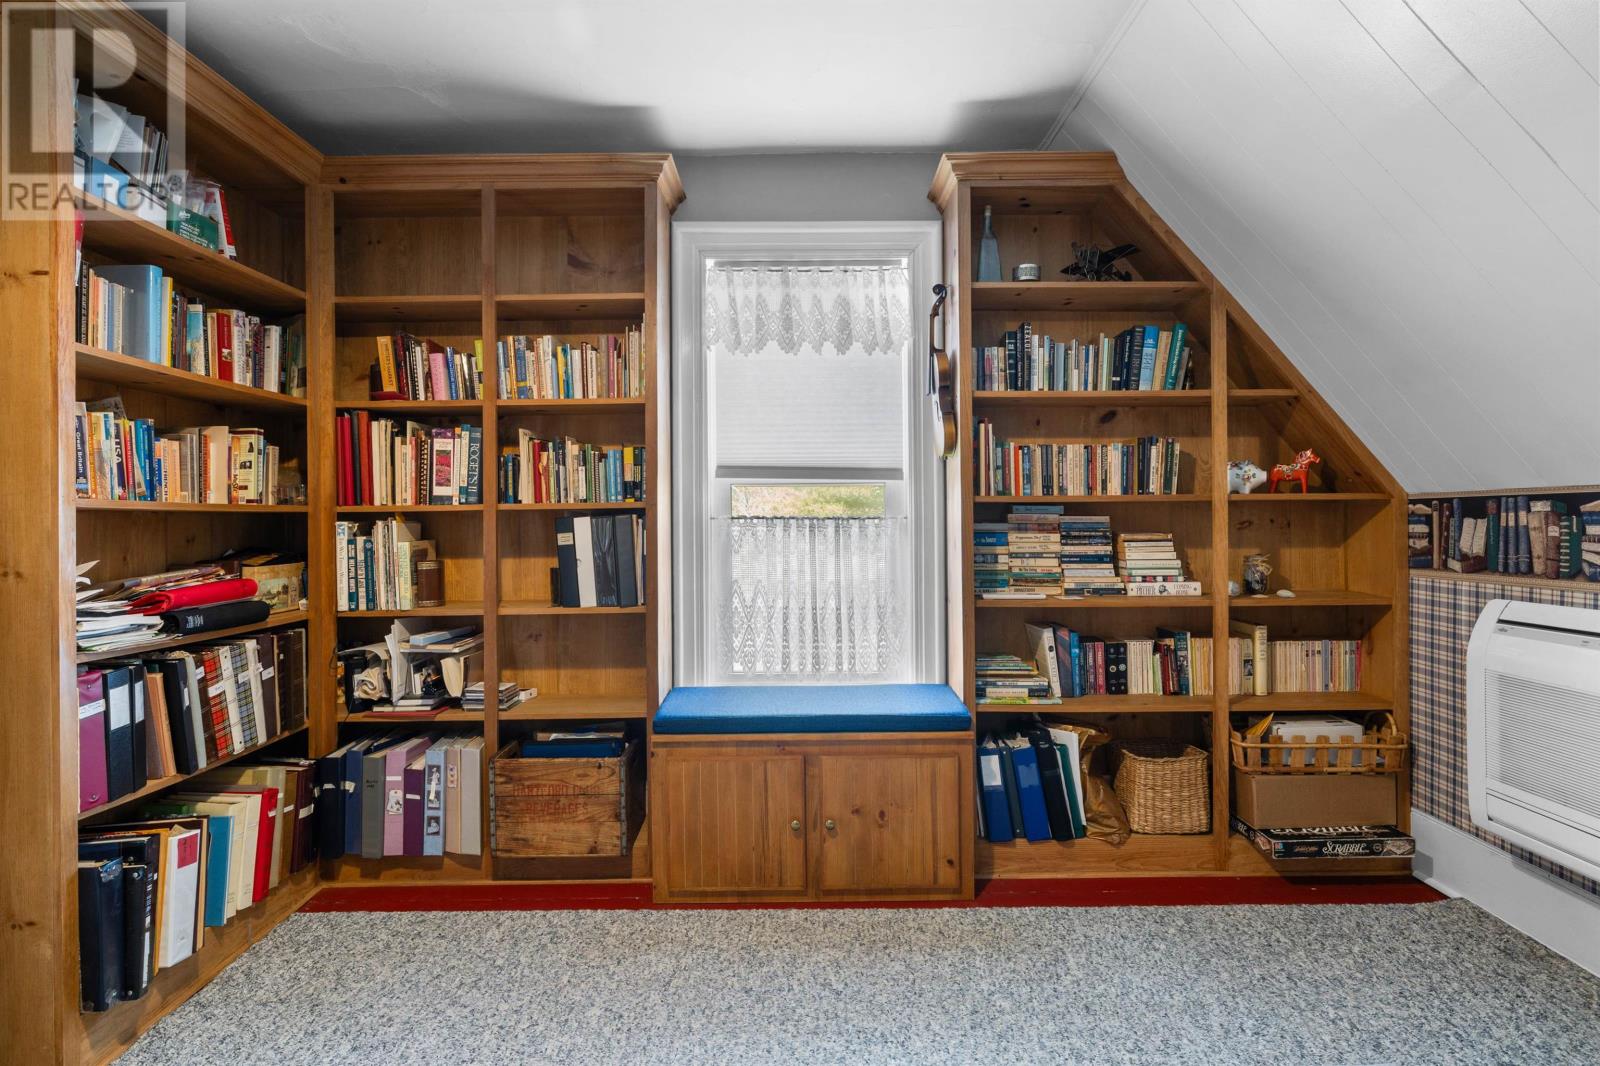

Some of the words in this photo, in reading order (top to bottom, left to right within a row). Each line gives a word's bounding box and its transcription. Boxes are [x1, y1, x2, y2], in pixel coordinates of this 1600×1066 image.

[469, 443, 479, 484] ROGET'S
[526, 802, 588, 815] BEVERAGES
[1322, 841, 1368, 855] SCRABBLE
